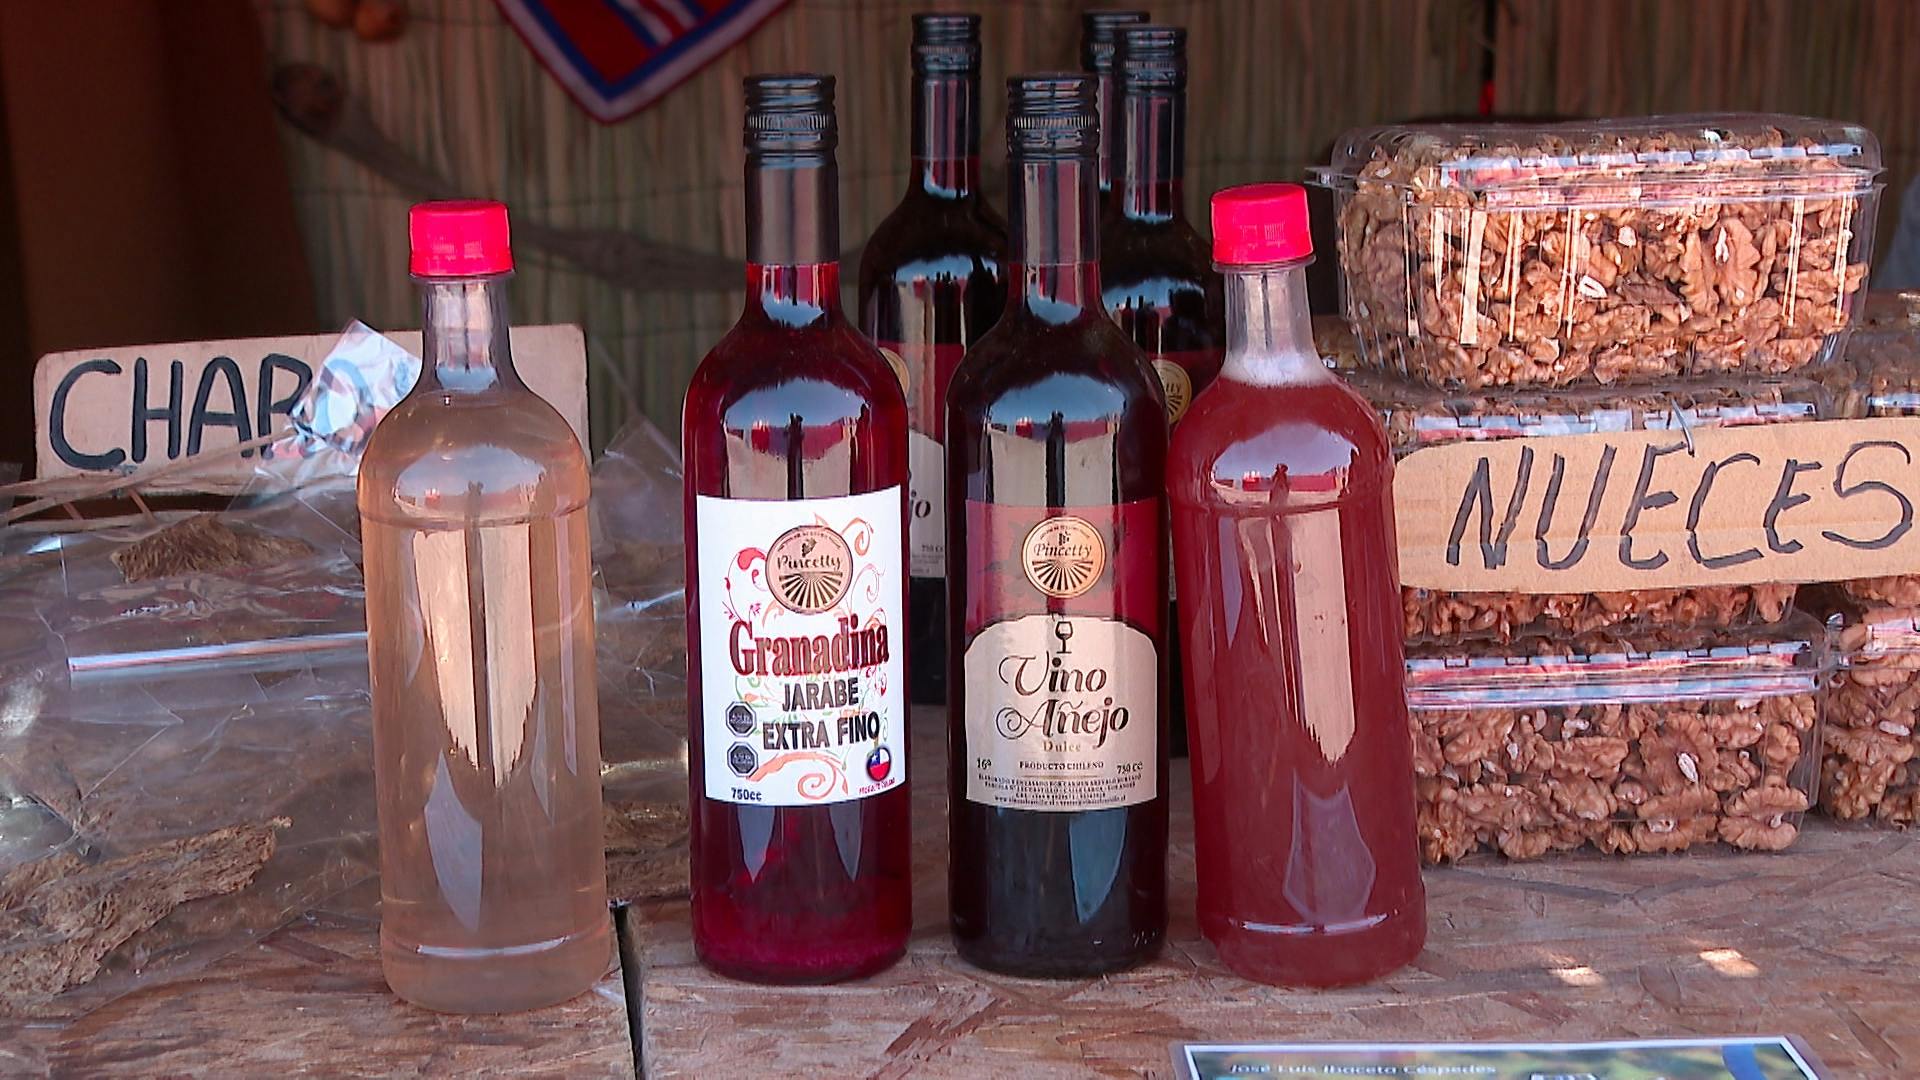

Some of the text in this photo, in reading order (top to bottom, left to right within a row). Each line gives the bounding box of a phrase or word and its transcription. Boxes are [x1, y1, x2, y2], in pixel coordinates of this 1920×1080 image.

[49, 354, 316, 471] CHAR
[1446, 440, 1913, 570] NUECES
[729, 613, 890, 676] Granadina
[782, 677, 859, 712] JARABE
[998, 651, 1107, 696] Vino
[762, 711, 880, 750] EXTRA FINO
[995, 697, 1130, 748] Añejo
[1043, 740, 1081, 752] Dulce
[731, 787, 763, 801] 750cc
[1278, 1064, 1316, 1073] Luis
